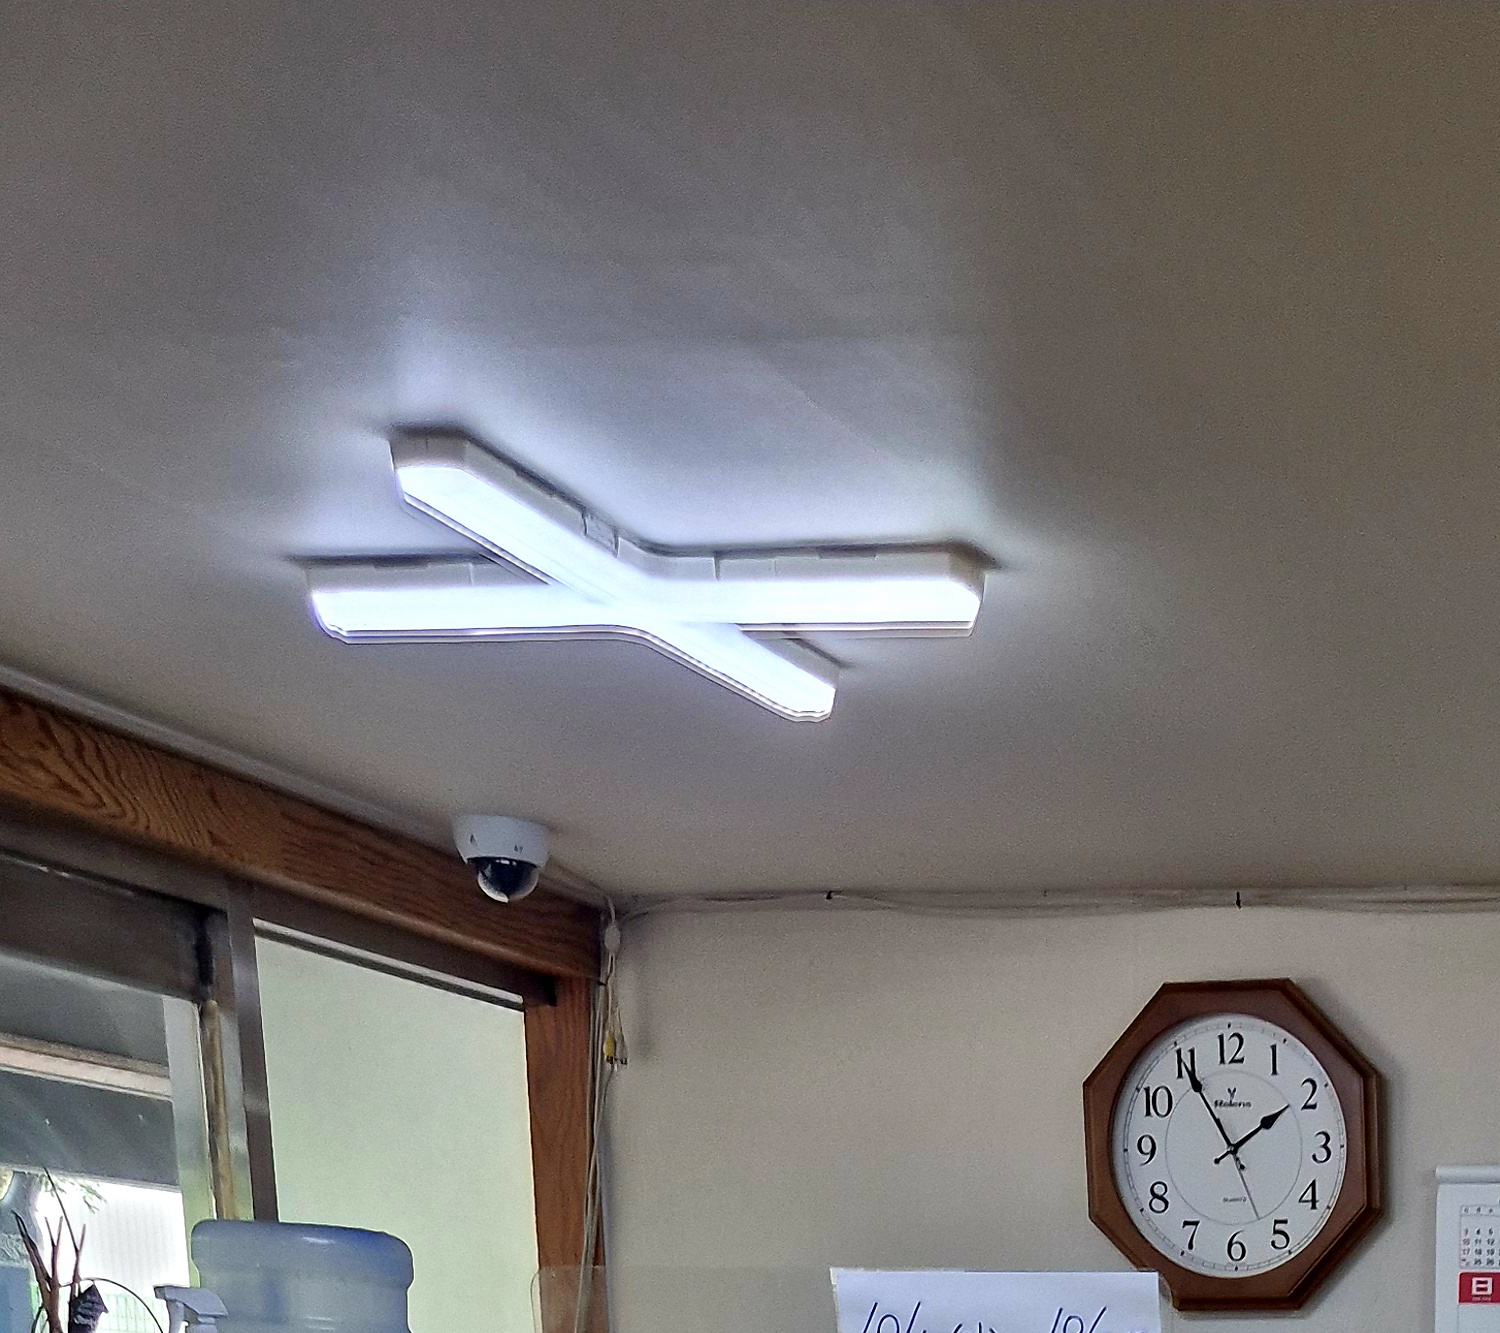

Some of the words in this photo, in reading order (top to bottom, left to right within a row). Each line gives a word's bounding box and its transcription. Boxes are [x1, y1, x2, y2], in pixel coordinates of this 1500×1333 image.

[1175, 1047, 1196, 1079] 11
[1217, 1032, 1245, 1065] 12
[1270, 1044, 1279, 1076] 1
[1143, 1085, 1173, 1118] 10
[1301, 1078, 1318, 1110] 2
[1137, 1134, 1157, 1166] 9
[1311, 1131, 1332, 1164] 3
[1149, 1181, 1169, 1213] 8
[1298, 1179, 1319, 1210] 4
[1182, 1220, 1201, 1251] 7
[1227, 1230, 1247, 1262] 6
[1270, 1219, 1291, 1250] 5
[1473, 1278, 1493, 1296] 日
